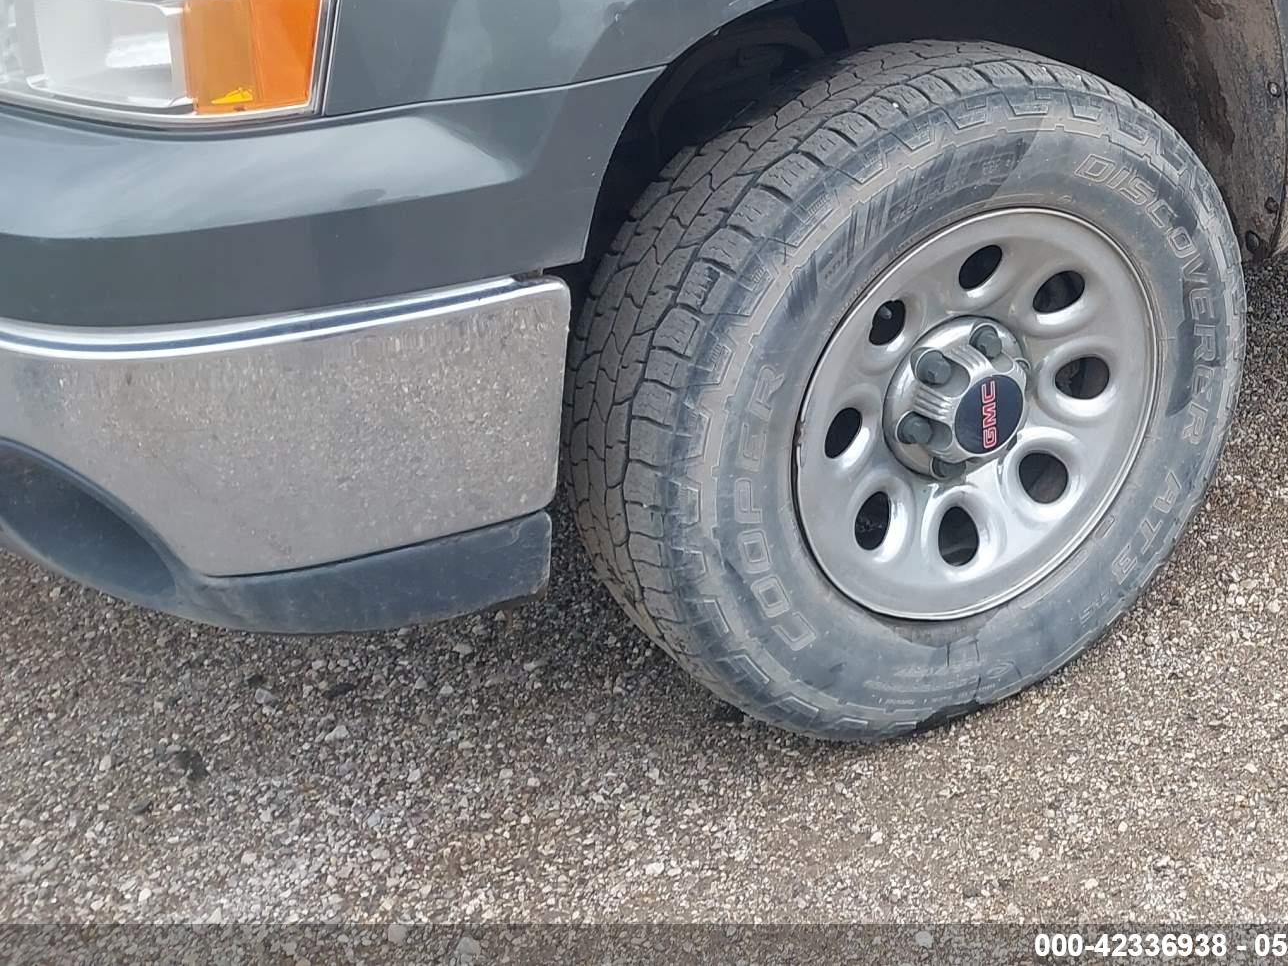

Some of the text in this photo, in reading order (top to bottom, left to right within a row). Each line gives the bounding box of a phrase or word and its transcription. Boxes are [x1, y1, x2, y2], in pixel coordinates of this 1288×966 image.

[1074, 153, 1217, 444] DISCOVERER
[734, 364, 817, 651] COOPER
[981, 380, 997, 449] GMC
[1112, 470, 1182, 585] AT3
